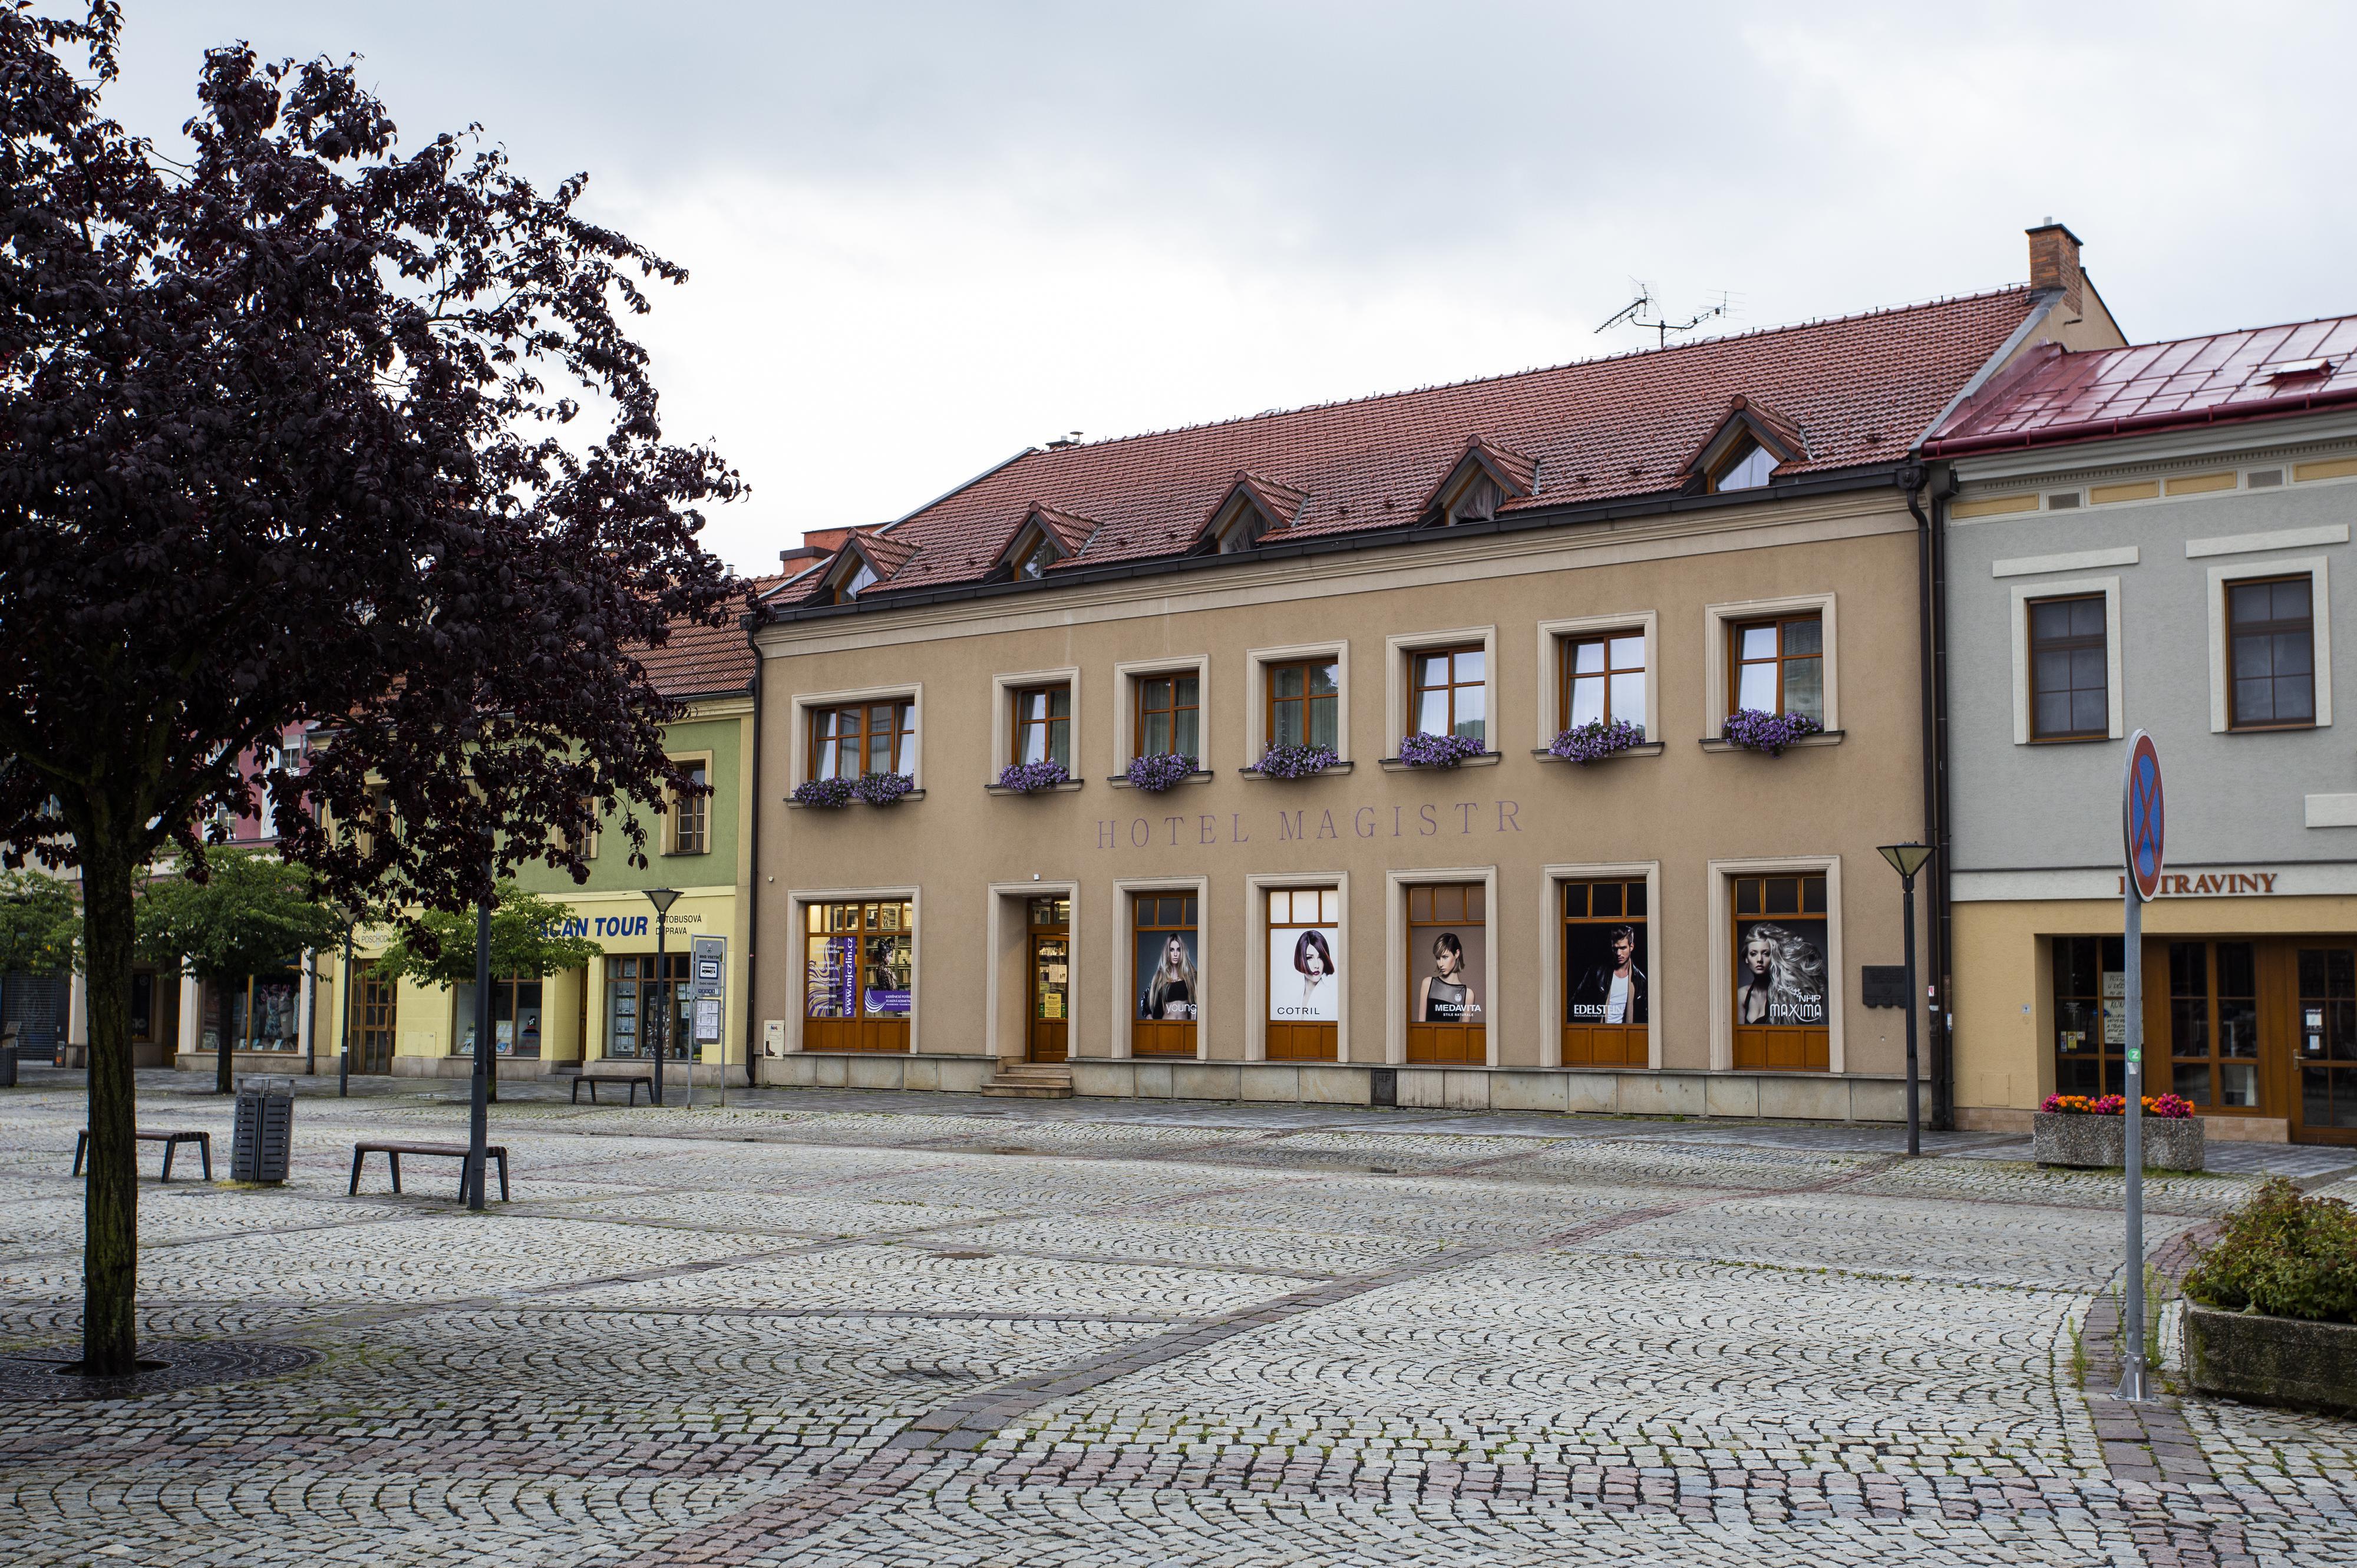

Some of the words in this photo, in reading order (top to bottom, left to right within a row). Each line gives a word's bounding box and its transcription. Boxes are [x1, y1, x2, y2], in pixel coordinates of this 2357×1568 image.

[1097, 813, 1249, 849] HOTEL
[1279, 800, 1522, 841] MAGISTR
[2118, 873, 2278, 894] TRAVINY
[595, 916, 648, 937] TOUR
[655, 913, 702, 923] ATOBUSOVÁ
[655, 927, 687, 935] DPRAVA
[845, 938, 854, 1015] www.mjczlin.cz
[1166, 1003, 1197, 1014] young
[1574, 1004, 1624, 1014] EDELSTEIN
[1770, 1003, 1821, 1021] MAXIMA
